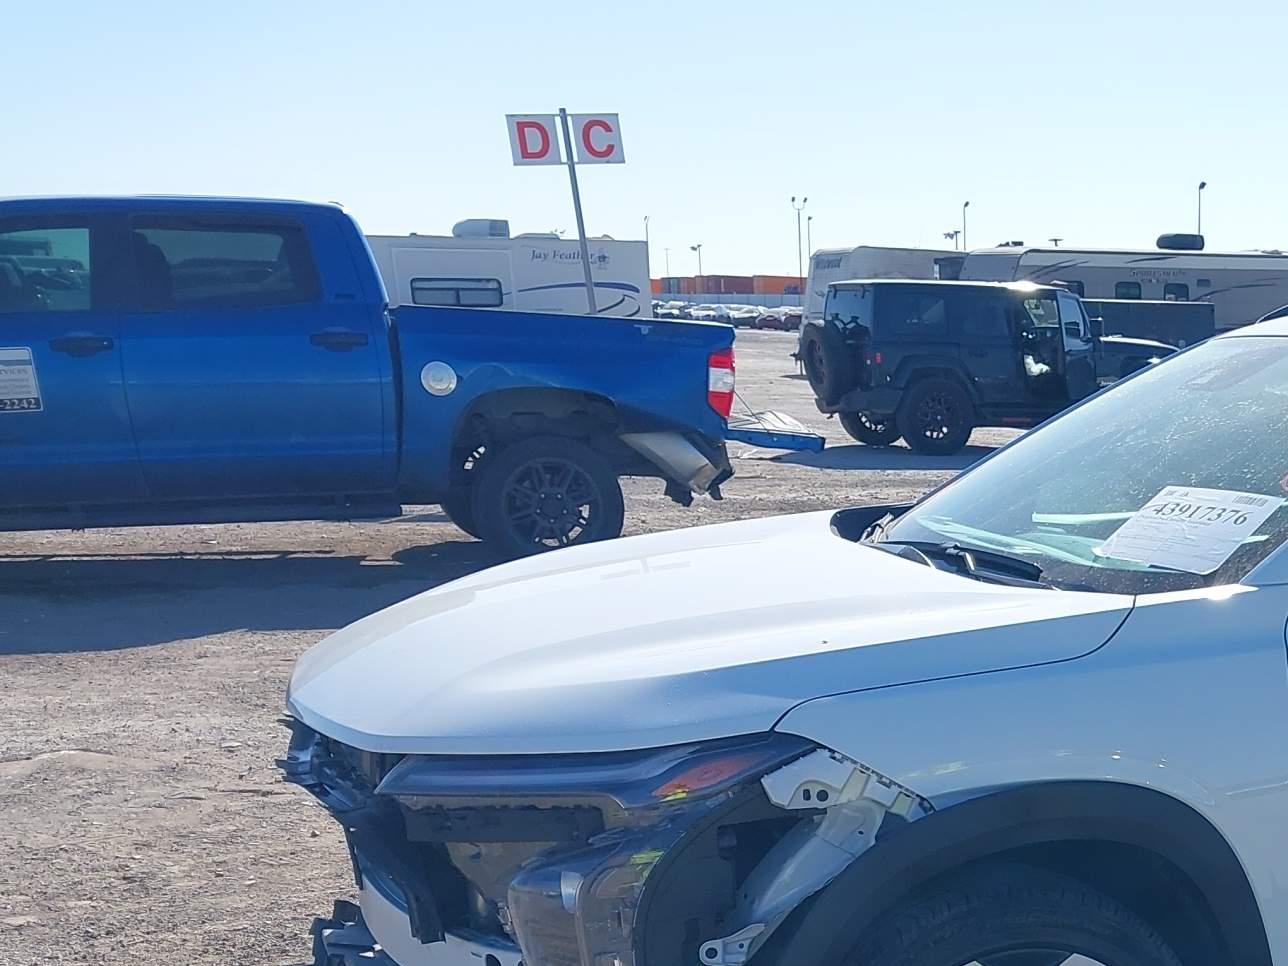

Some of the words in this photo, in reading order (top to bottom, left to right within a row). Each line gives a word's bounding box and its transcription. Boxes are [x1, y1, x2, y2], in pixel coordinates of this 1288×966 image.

[516, 121, 550, 159] D
[582, 120, 615, 158] C
[532, 249, 548, 261] Jay
[1151, 502, 1253, 526] 43917376
